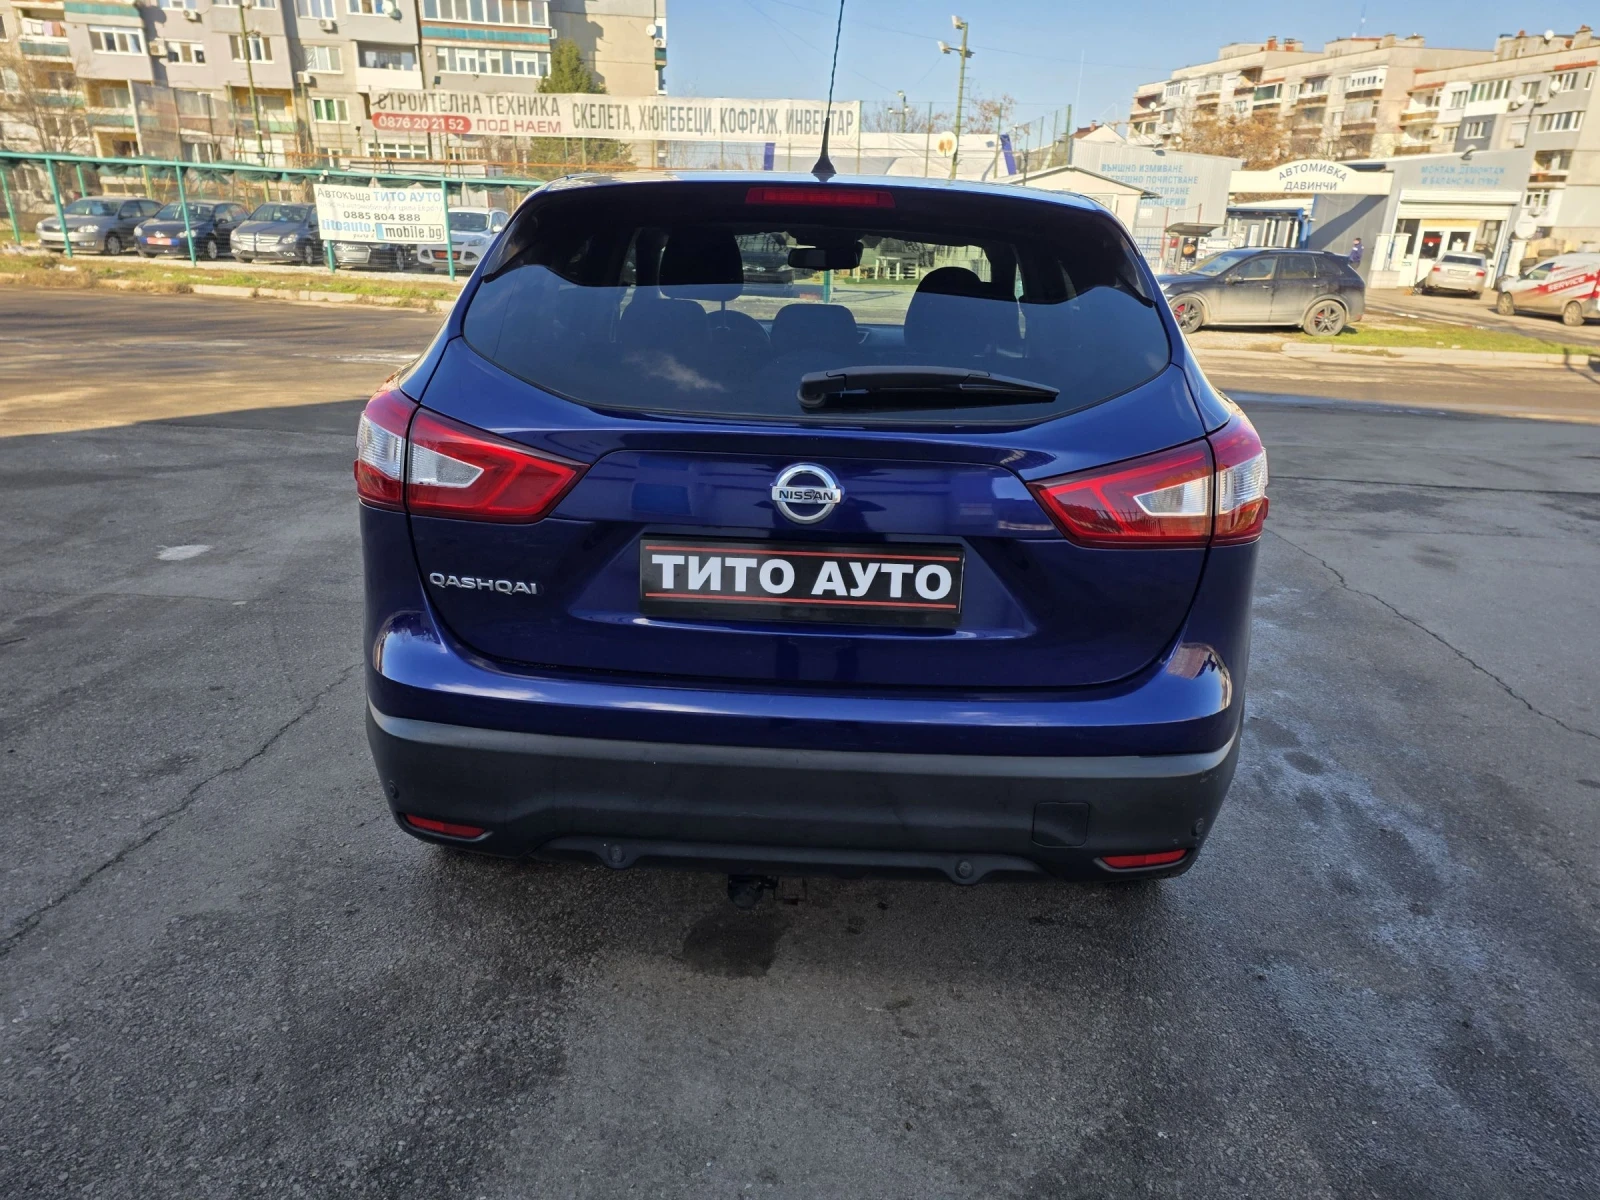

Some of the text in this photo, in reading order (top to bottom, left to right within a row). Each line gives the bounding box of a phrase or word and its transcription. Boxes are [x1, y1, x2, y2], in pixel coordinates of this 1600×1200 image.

[378, 92, 560, 116] СТРОИТЕЛНА ТЕХНИКА
[378, 115, 464, 130] 0876 20 21 52
[477, 118, 561, 133] ПОД НАЕМ
[572, 103, 635, 133] СКЕЛЕТА,
[639, 105, 716, 136] ХЮНЕБЕЦИ,
[720, 107, 782, 136] КОФРАЖ,
[1101, 164, 1183, 173] ВЪНШНО ИЗМИВАНЕ
[1279, 163, 1347, 182] АВТОМИВКА
[1146, 176, 1198, 184] ПОЧИСТВАНЕ
[1284, 181, 1338, 191] ДАВИНЧИ
[317, 187, 441, 202] Автокъща ТИТО АУТО
[343, 211, 421, 221] 0885 804 888
[1547, 276, 1585, 293] SERVICE
[779, 490, 834, 501] NISSAN
[429, 572, 537, 596] QASHQAI
[651, 554, 952, 600] ТИТО АУТО
